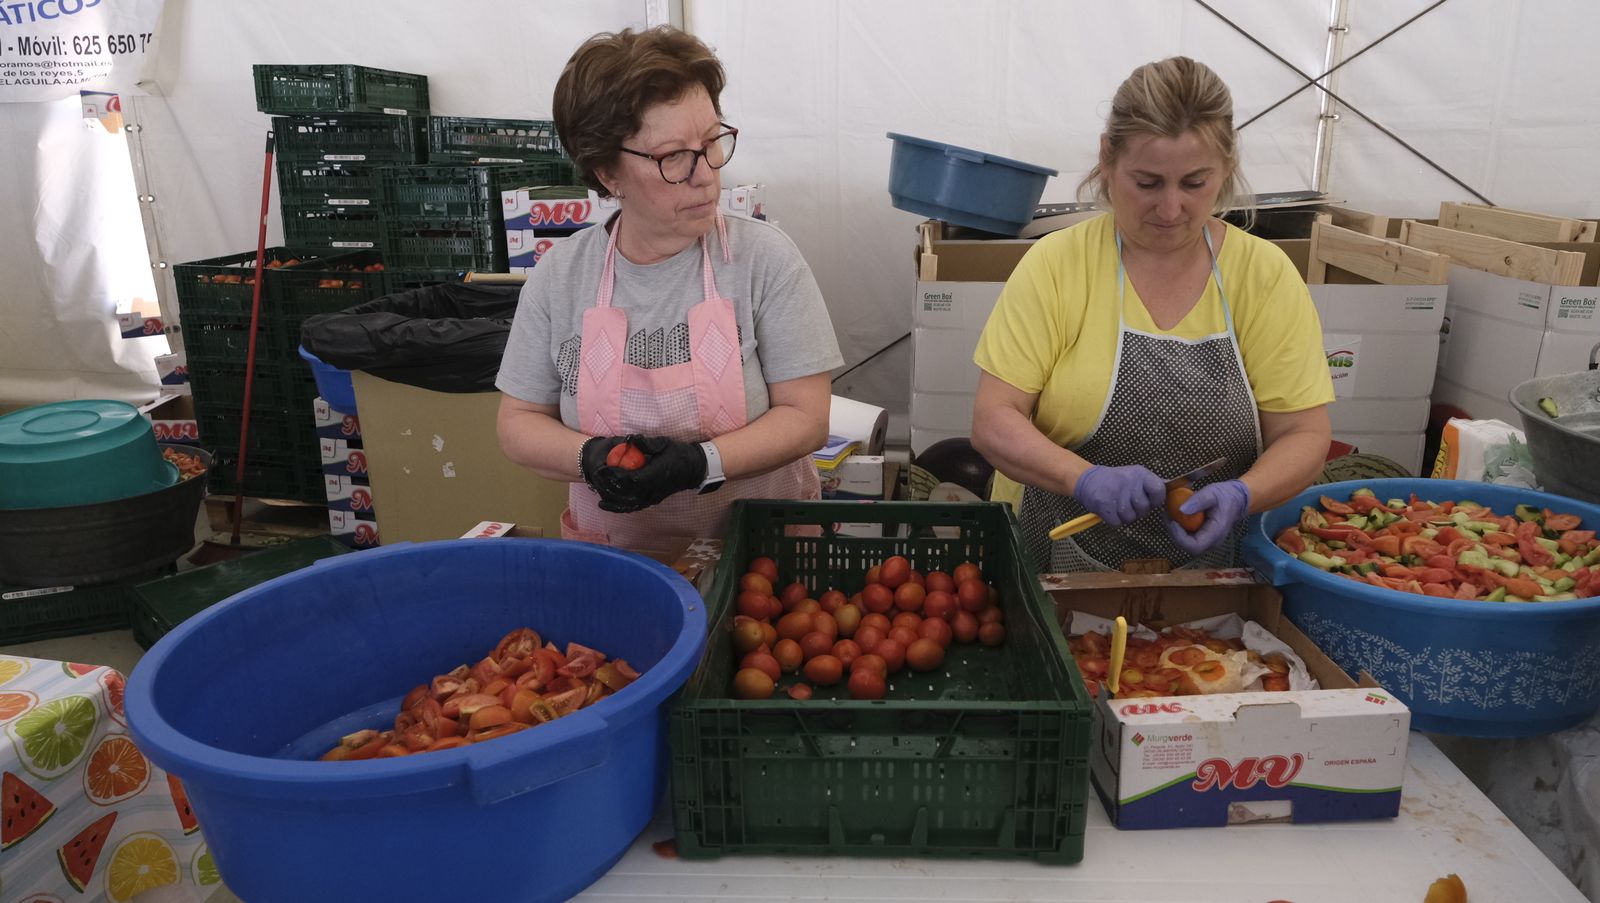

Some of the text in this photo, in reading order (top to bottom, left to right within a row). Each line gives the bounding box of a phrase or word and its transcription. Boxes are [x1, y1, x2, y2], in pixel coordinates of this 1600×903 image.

[18, 35, 67, 56] Móvil:
[73, 35, 102, 55] 625
[108, 33, 136, 54] 650
[528, 200, 592, 226] MV
[924, 292, 941, 300] Green
[1561, 297, 1597, 306] Green Box
[1192, 753, 1304, 792] MV
